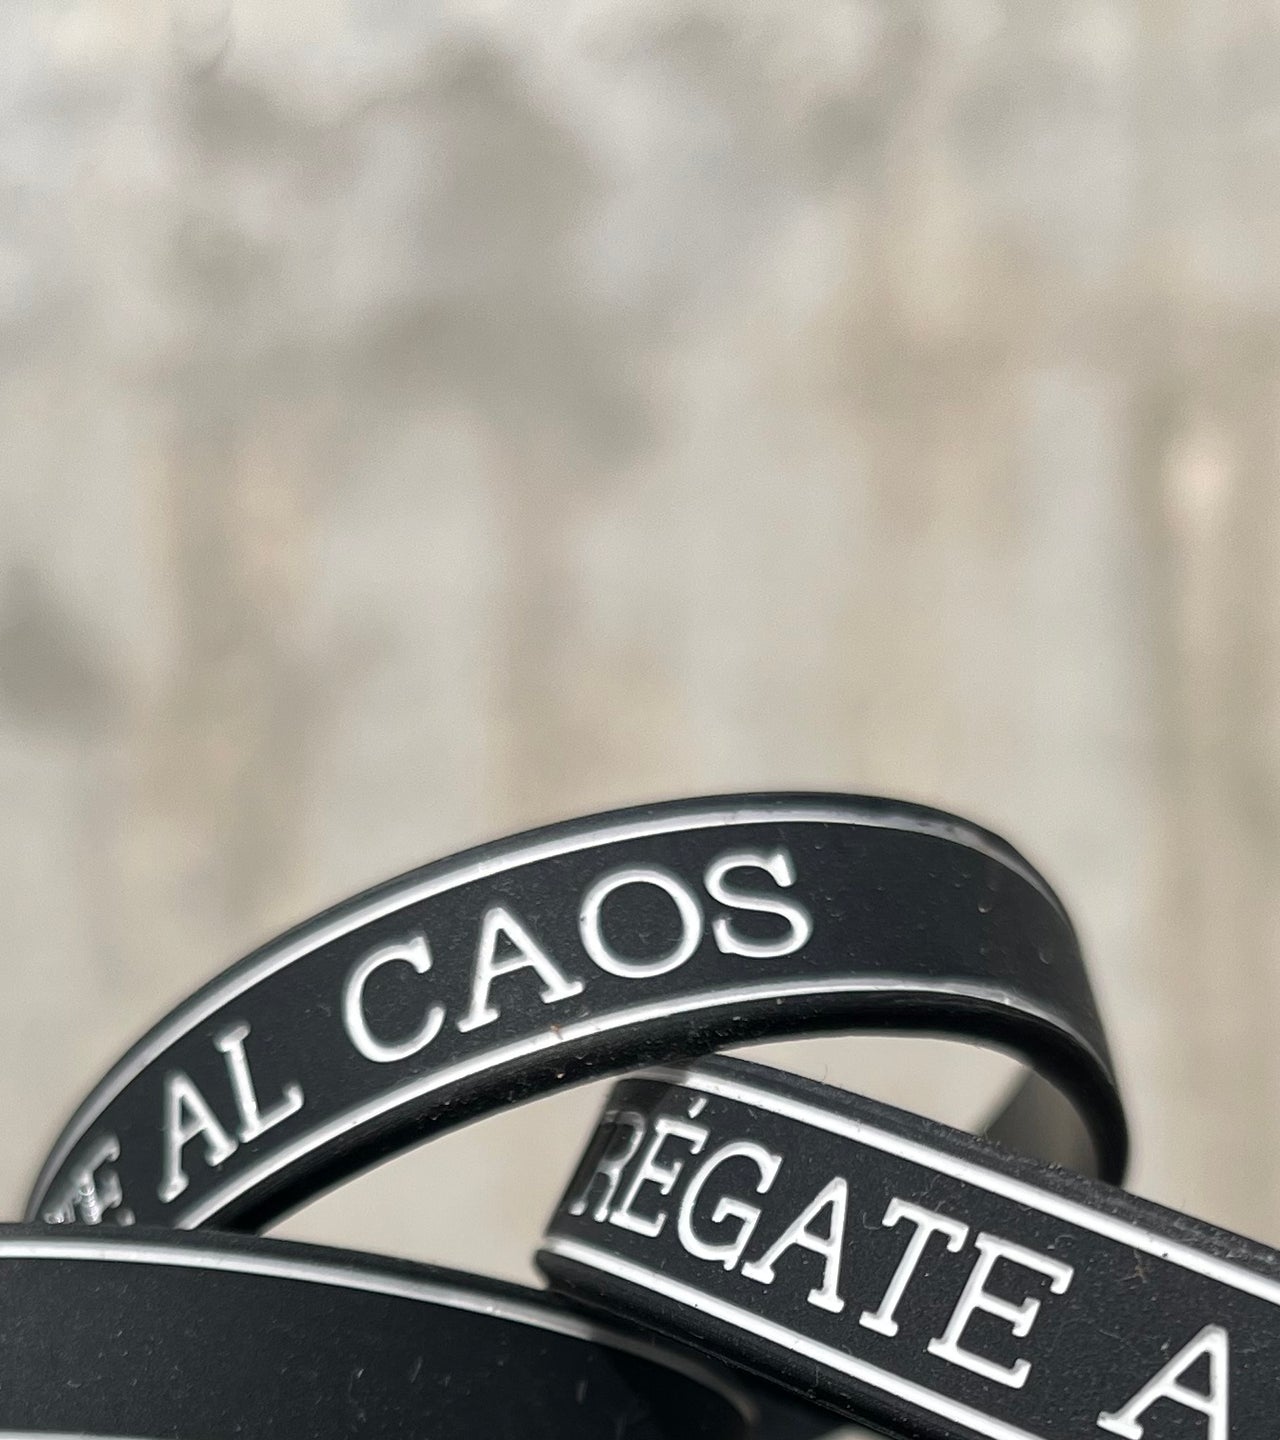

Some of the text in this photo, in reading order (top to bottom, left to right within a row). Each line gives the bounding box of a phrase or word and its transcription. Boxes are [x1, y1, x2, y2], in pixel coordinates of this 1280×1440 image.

[157, 1022, 304, 1204] AL
[341, 848, 815, 1065] CAOS
[568, 1096, 1074, 1389] RÉGATE
